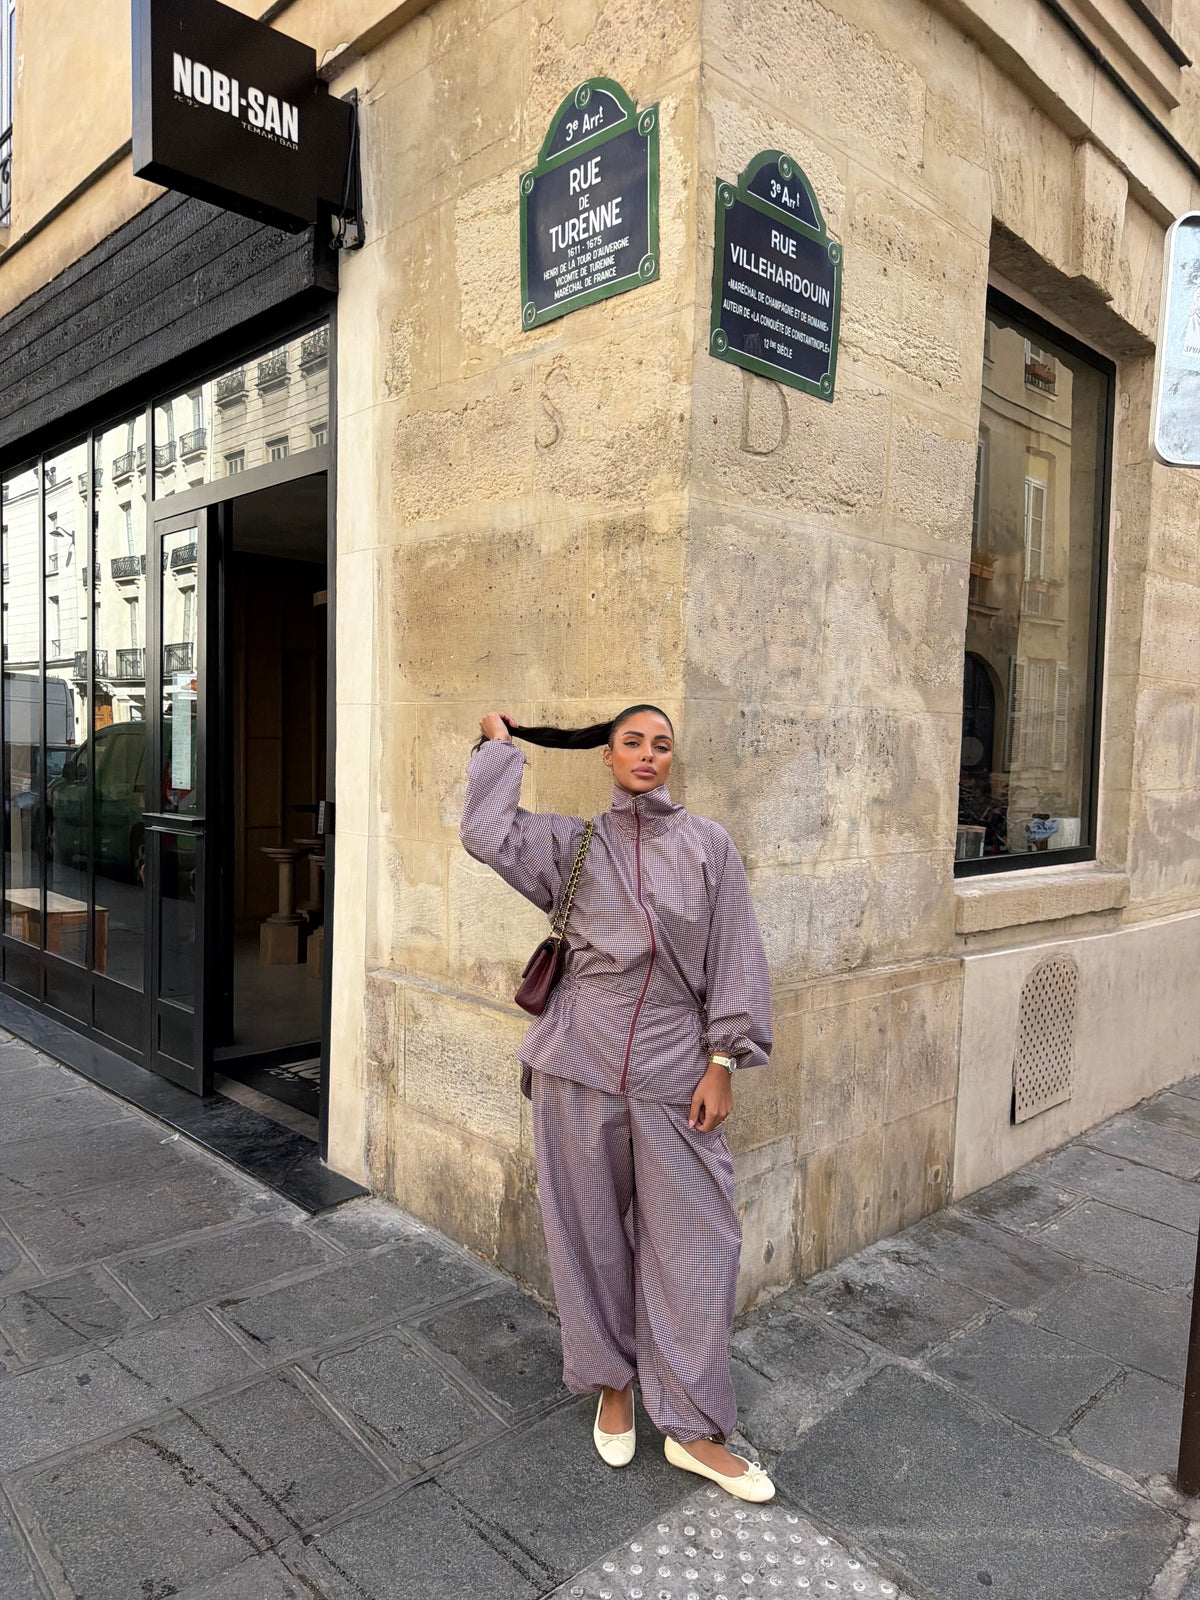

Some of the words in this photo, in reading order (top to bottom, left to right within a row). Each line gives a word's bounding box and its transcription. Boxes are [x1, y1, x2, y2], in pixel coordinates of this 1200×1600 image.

[173, 51, 299, 143] NOBI-SAN
[241, 120, 277, 142] TEMAKI
[279, 137, 299, 150] BAR
[565, 119, 579, 141] 3e
[569, 155, 601, 196] RUE
[770, 179, 781, 198] 3e
[578, 195, 590, 211] DE
[549, 197, 622, 253] TURENNE
[543, 266, 559, 281] HENRI
[560, 262, 567, 274] DE
[568, 258, 576, 270] LA
[577, 252, 592, 266] TOUR
[593, 236, 630, 260] D'AUVERGNE
[567, 244, 581, 258] 1611
[586, 235, 602, 249] 1675
[771, 229, 797, 260] RUE
[554, 280, 583, 300] MARÉCHAL
[584, 276, 593, 287] DE
[593, 266, 617, 284] FRANCE
[555, 269, 579, 287] VICOMTE
[580, 265, 588, 277] DE
[589, 254, 616, 273] TURENNE
[730, 242, 831, 309] VILLEHARDOUIN
[723, 298, 744, 316] AUTEUR
[743, 306, 751, 319] DE
[760, 314, 784, 334] CONQUÊTE
[784, 325, 791, 337] DE
[757, 291, 765, 303] DE
[765, 294, 794, 317] CHAMPAGNE
[794, 308, 801, 319] ET
[801, 311, 807, 323] DE
[763, 338, 769, 349] 12
[776, 342, 792, 358] SIÈCLE
